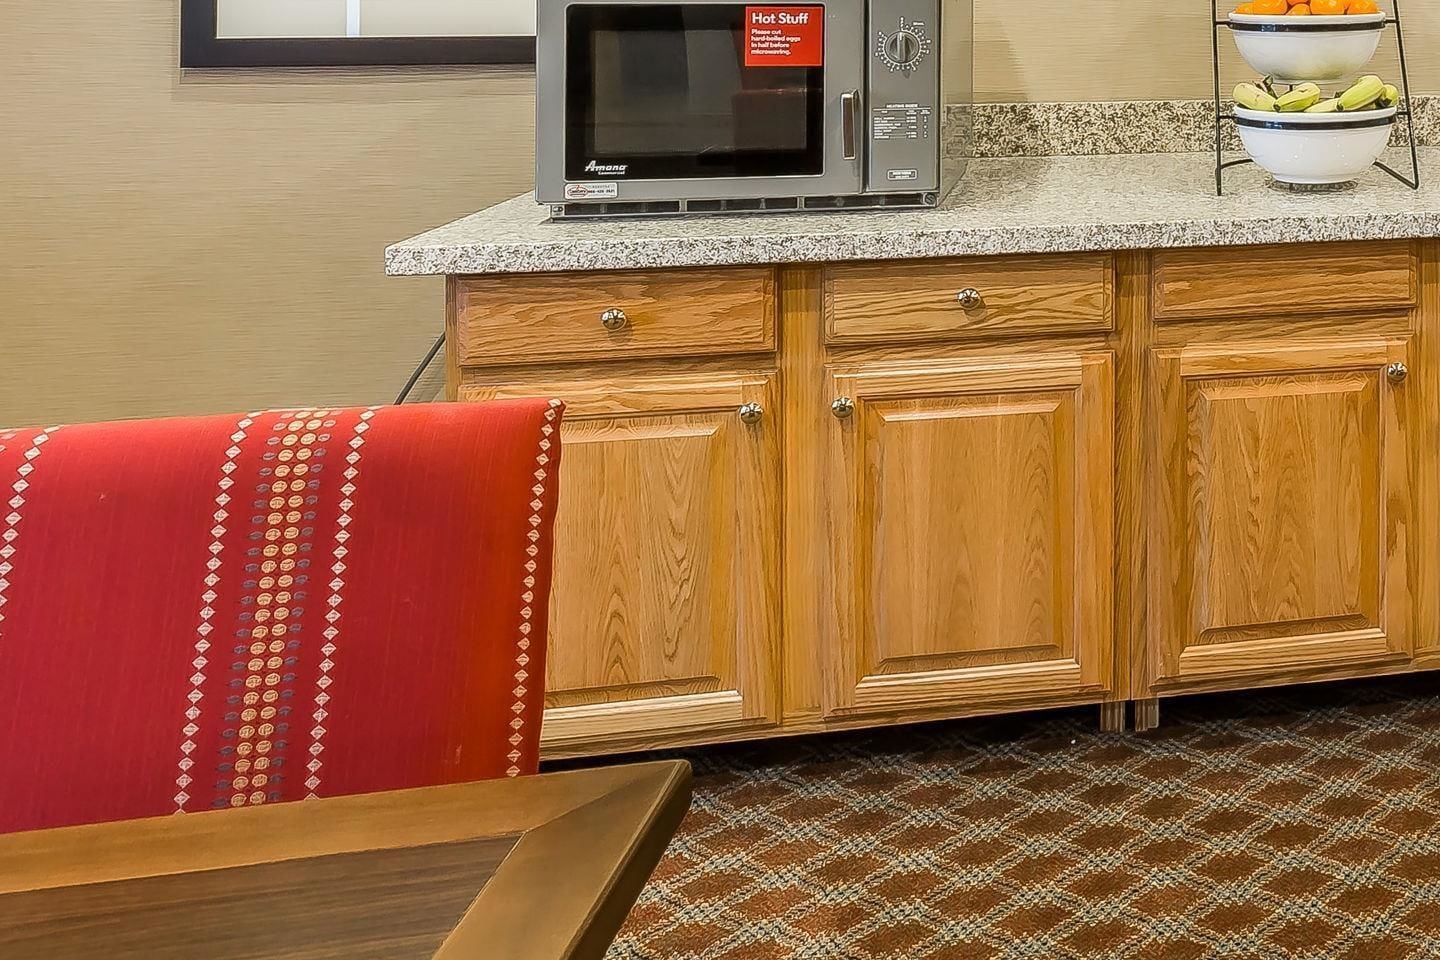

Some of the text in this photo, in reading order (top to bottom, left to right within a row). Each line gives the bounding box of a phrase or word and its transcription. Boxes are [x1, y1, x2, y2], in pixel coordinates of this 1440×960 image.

[752, 12, 809, 24] Hot Stuff
[584, 160, 628, 172] Amana
